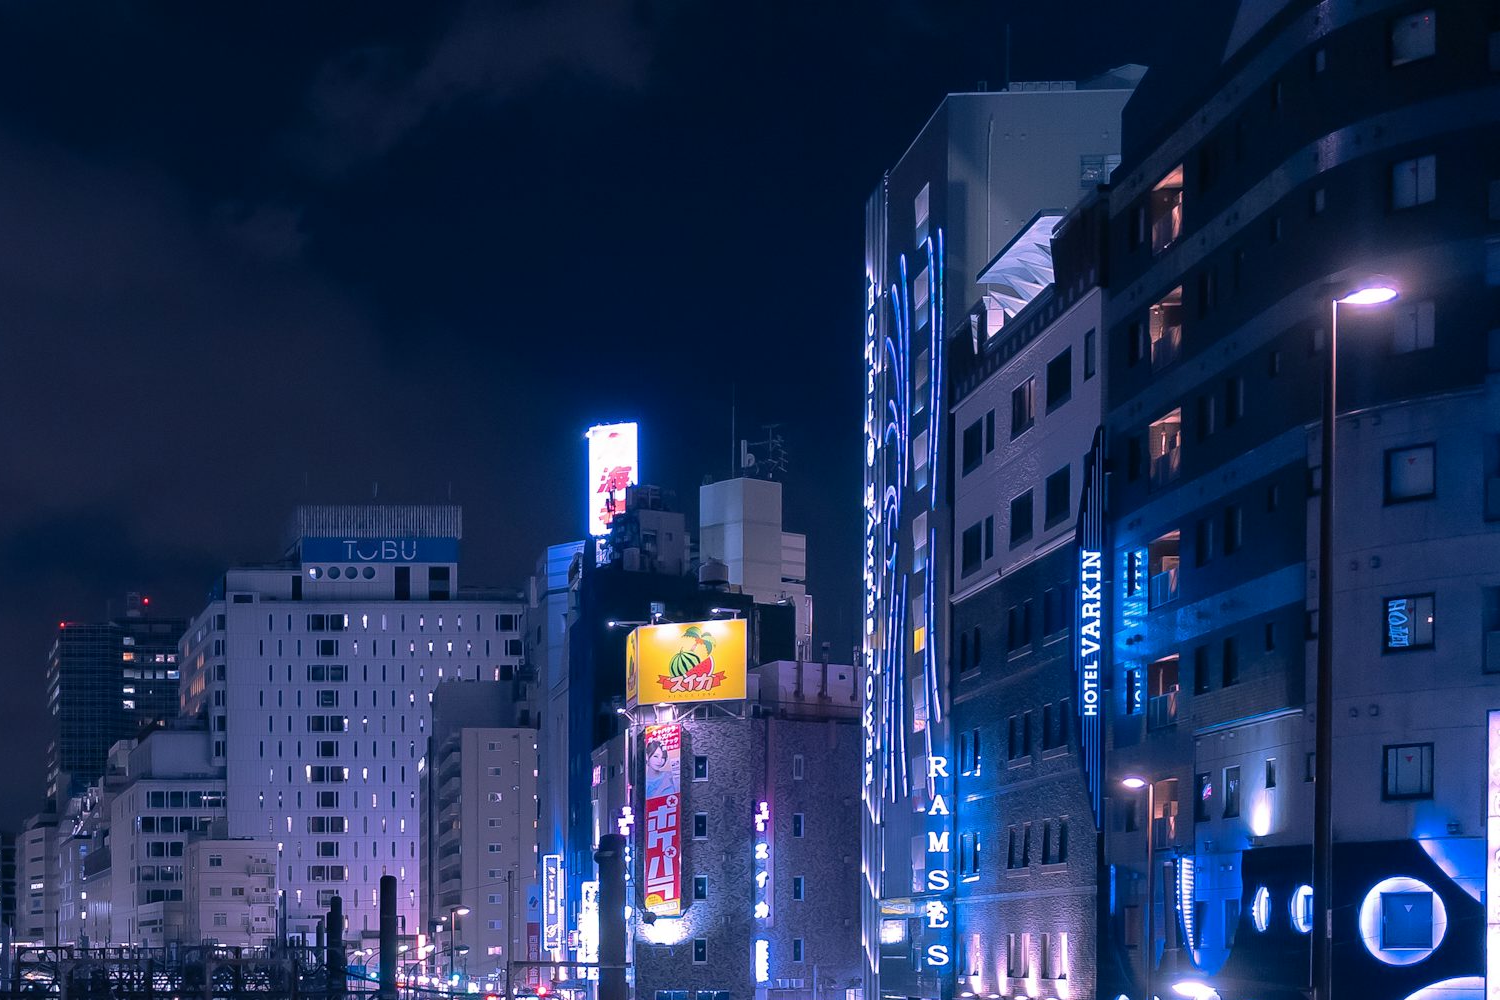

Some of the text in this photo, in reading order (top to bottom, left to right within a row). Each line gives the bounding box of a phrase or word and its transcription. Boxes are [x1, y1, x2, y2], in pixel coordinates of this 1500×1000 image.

[867, 281, 876, 422] HOTEL
[670, 674, 713, 693] スイカ
[1082, 550, 1101, 716] HOTEL VARKIN
[648, 794, 678, 900] ポケパラ
[927, 756, 949, 966] RAMSES
